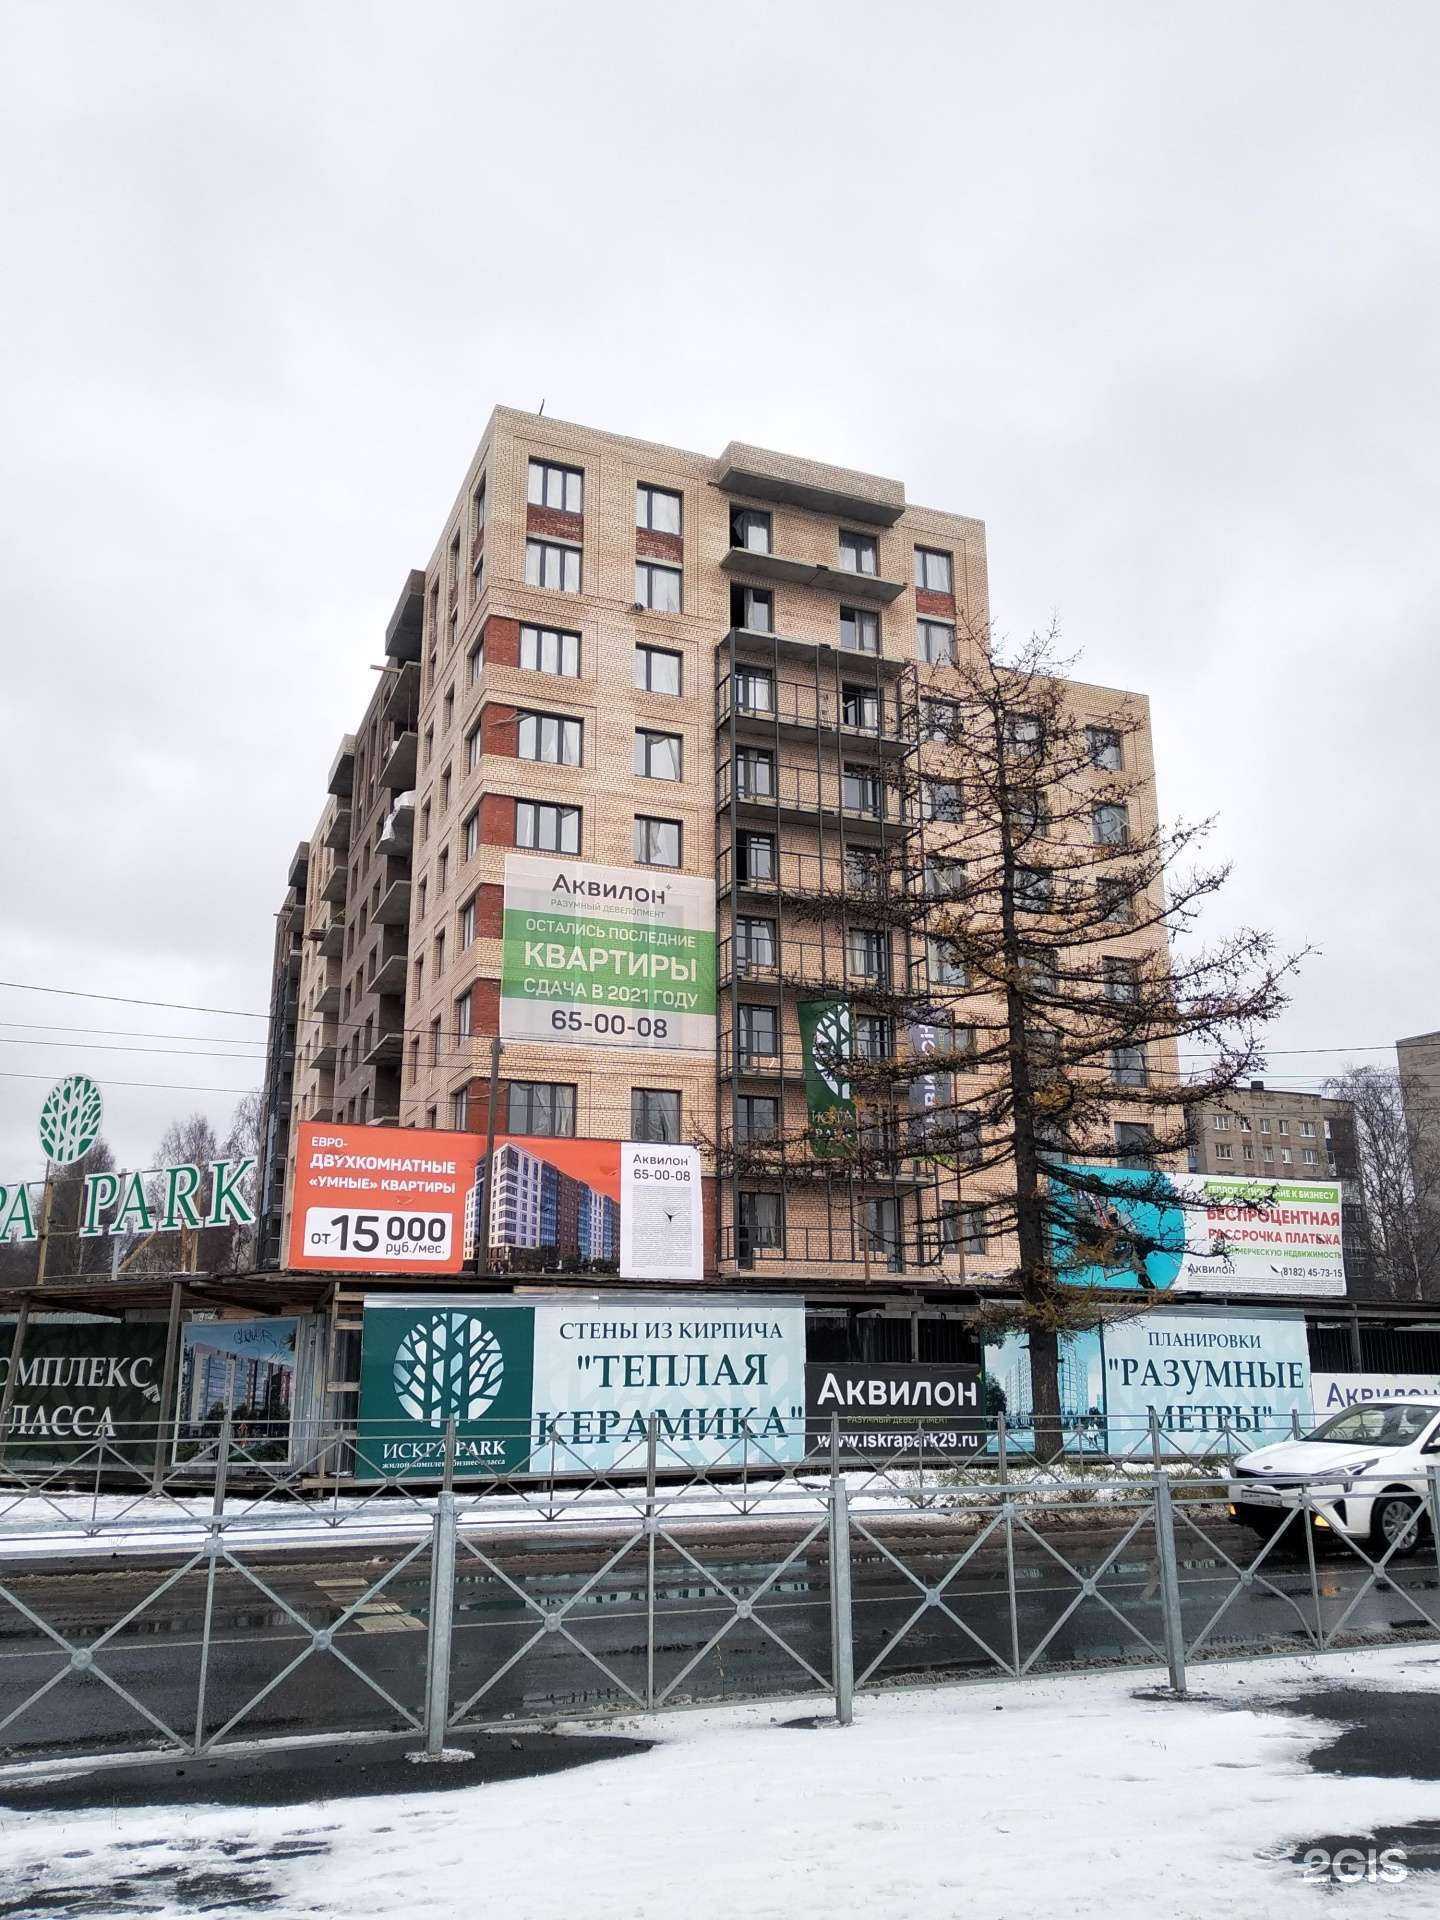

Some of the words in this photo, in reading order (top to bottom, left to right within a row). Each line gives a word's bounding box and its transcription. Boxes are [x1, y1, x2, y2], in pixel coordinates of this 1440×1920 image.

[550, 898, 601, 911] РАЗУМНЫЙ
[602, 904, 665, 919] ДЕВЕЛОПМЕНТ
[526, 918, 605, 939] ОСТАЛИСЬ
[609, 927, 696, 949] ПОСЛЕДНИЕ
[524, 941, 697, 983] КВАРТИРЫ
[523, 977, 588, 998] СДАЧА
[592, 984, 604, 999] В
[607, 985, 649, 1004] 2021
[653, 990, 699, 1010] ГОДУ
[551, 1009, 668, 1039] 65-00-08
[311, 1136, 349, 1148] ЕВРО-
[309, 1153, 456, 1175] ДВУХКОМНАТНЫЕ
[309, 1175, 378, 1190] «УМНЫЕ»
[381, 1179, 456, 1194] КВАРТИРЫ
[633, 1168, 691, 1182] 65-00-08
[80, 1157, 258, 1236] PARK
[1298, 1190, 1334, 1200] БИЗНЕСУ
[1207, 1207, 1340, 1227] БЕСПРОЦЕНТНАЯ
[1208, 1228, 1283, 1243] РАССРОЧКА
[1285, 1232, 1341, 1246] ПЛАТЕЖА
[385, 1243, 446, 1256] руб./мес.
[1280, 1267, 1306, 1278] (8182)
[1307, 1268, 1343, 1278] 45-73-15
[559, 1322, 638, 1340] СТЕНЫ
[645, 1322, 673, 1339] ИЗ
[679, 1322, 784, 1339] КИРПИЧА
[1148, 1332, 1261, 1350] ПЛАНИРОВКИ
[577, 1353, 769, 1389] "ТЕПЛАЯ
[1108, 1357, 1304, 1396] "РАЗУМНЫЕ
[534, 1405, 803, 1447] КЕРАМИКА"
[1146, 1405, 1272, 1434] МЕТРЫ"
[455, 1440, 506, 1457] PARK
